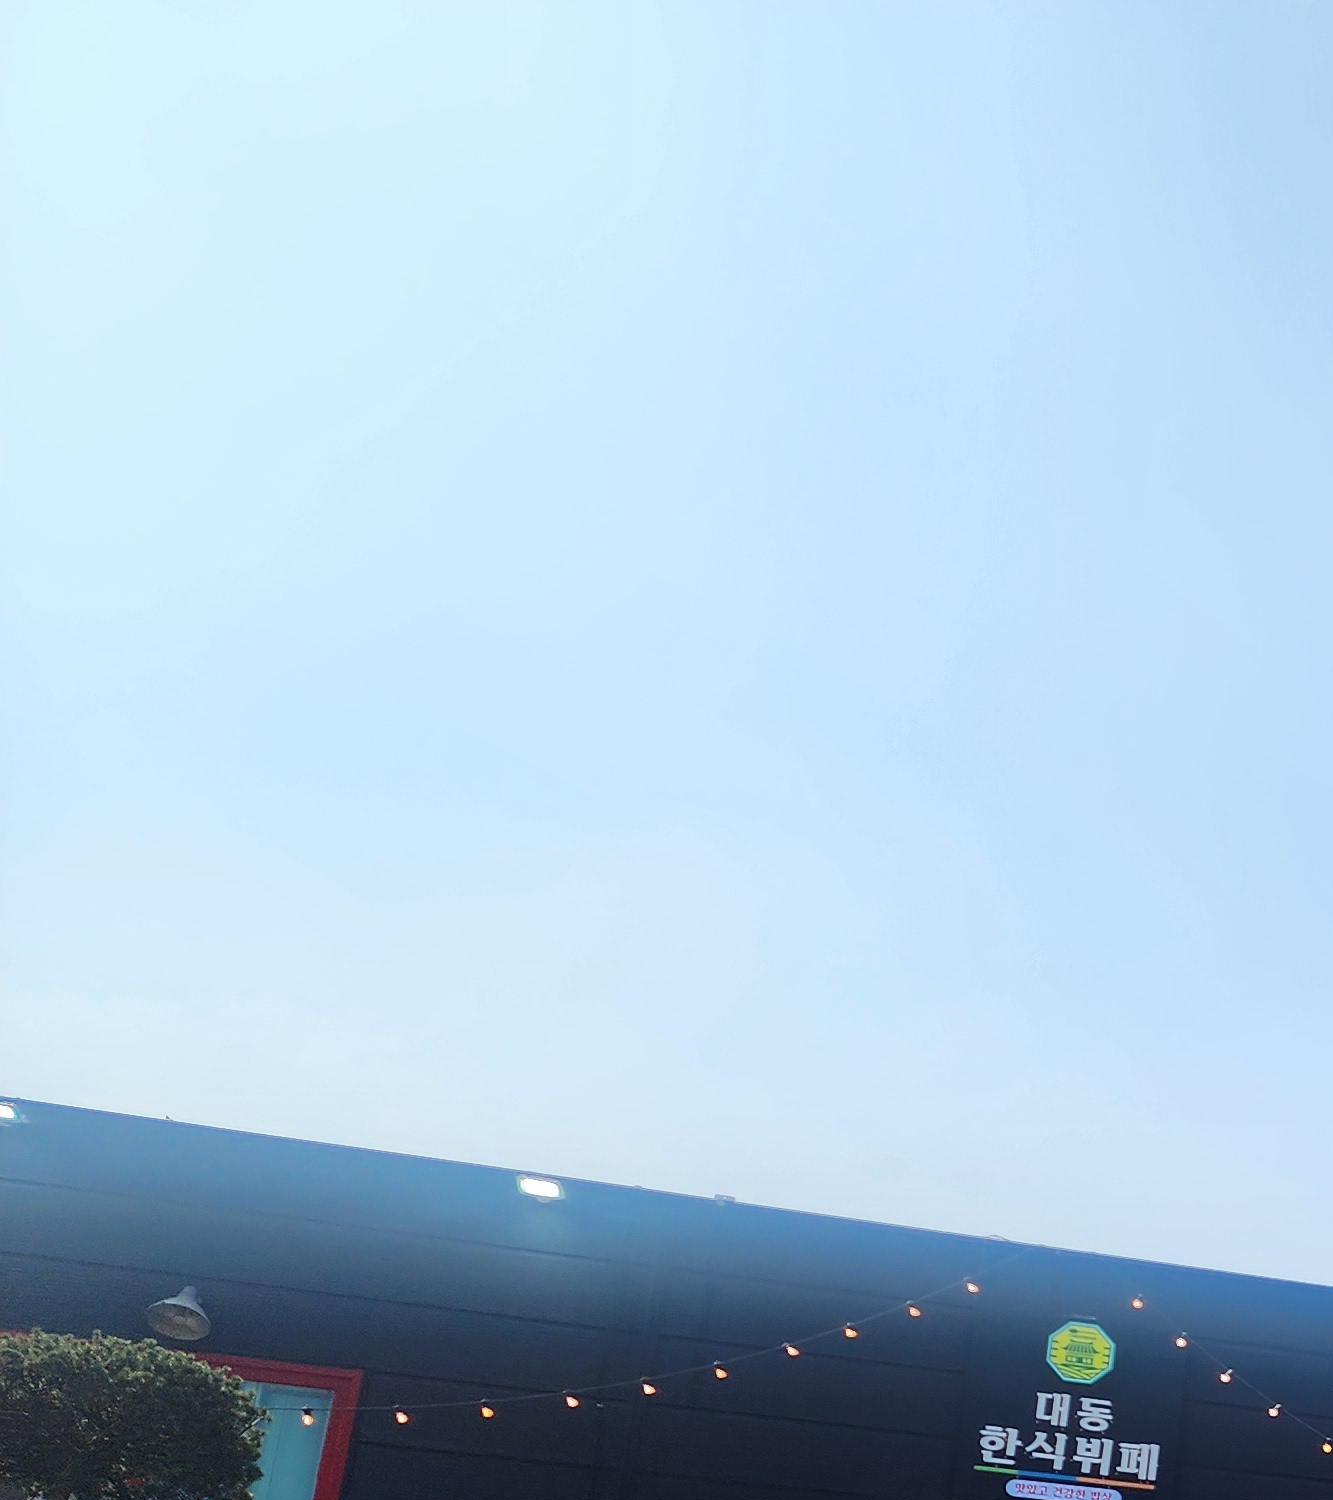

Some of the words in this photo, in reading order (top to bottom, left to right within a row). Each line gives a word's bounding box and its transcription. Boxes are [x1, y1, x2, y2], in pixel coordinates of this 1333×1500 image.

[1035, 1391, 1114, 1432] 대동
[979, 1425, 1161, 1481] 한식뷔페
[1015, 1482, 1048, 1496] 맛있고
[1052, 1486, 1086, 1500] 건강한
